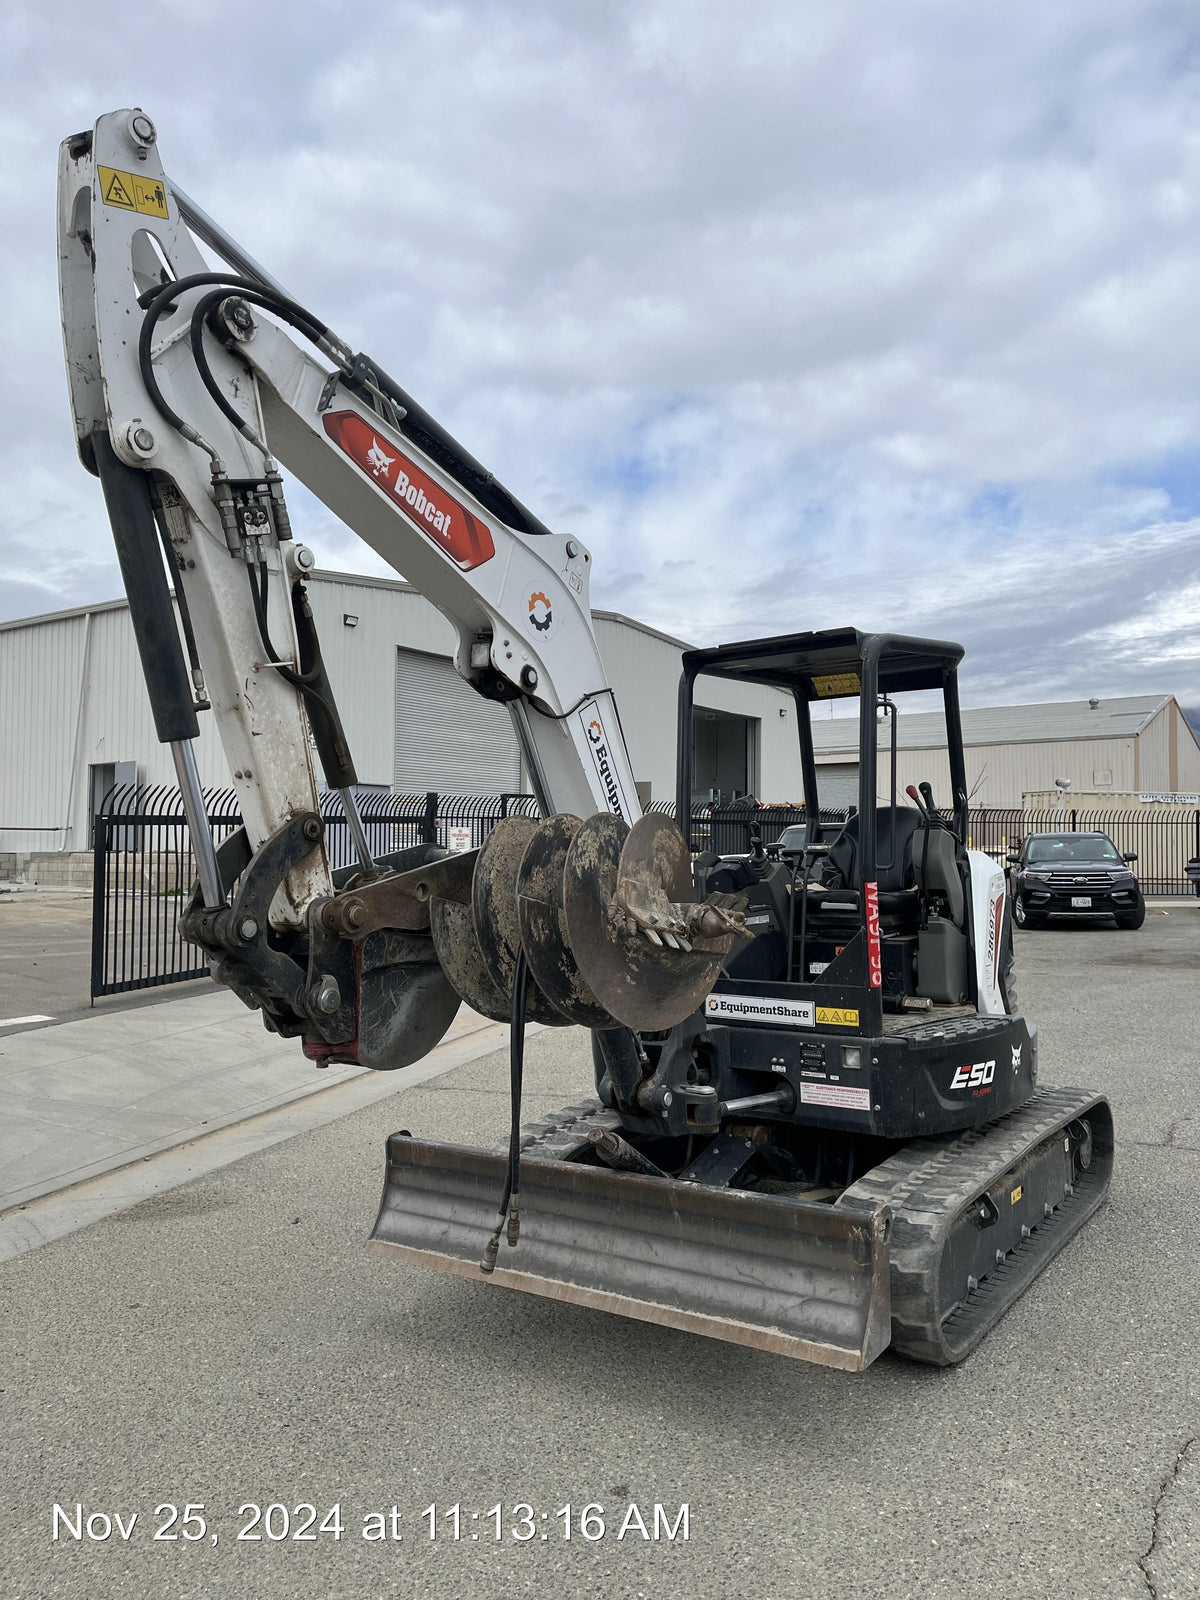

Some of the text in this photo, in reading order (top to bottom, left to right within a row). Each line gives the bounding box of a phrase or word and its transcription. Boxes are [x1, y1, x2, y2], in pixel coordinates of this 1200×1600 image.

[393, 470, 452, 537] Bobcat
[987, 899, 996, 962] 286973
[720, 1001, 809, 1018] EquipmentShare
[950, 1060, 996, 1089] E50
